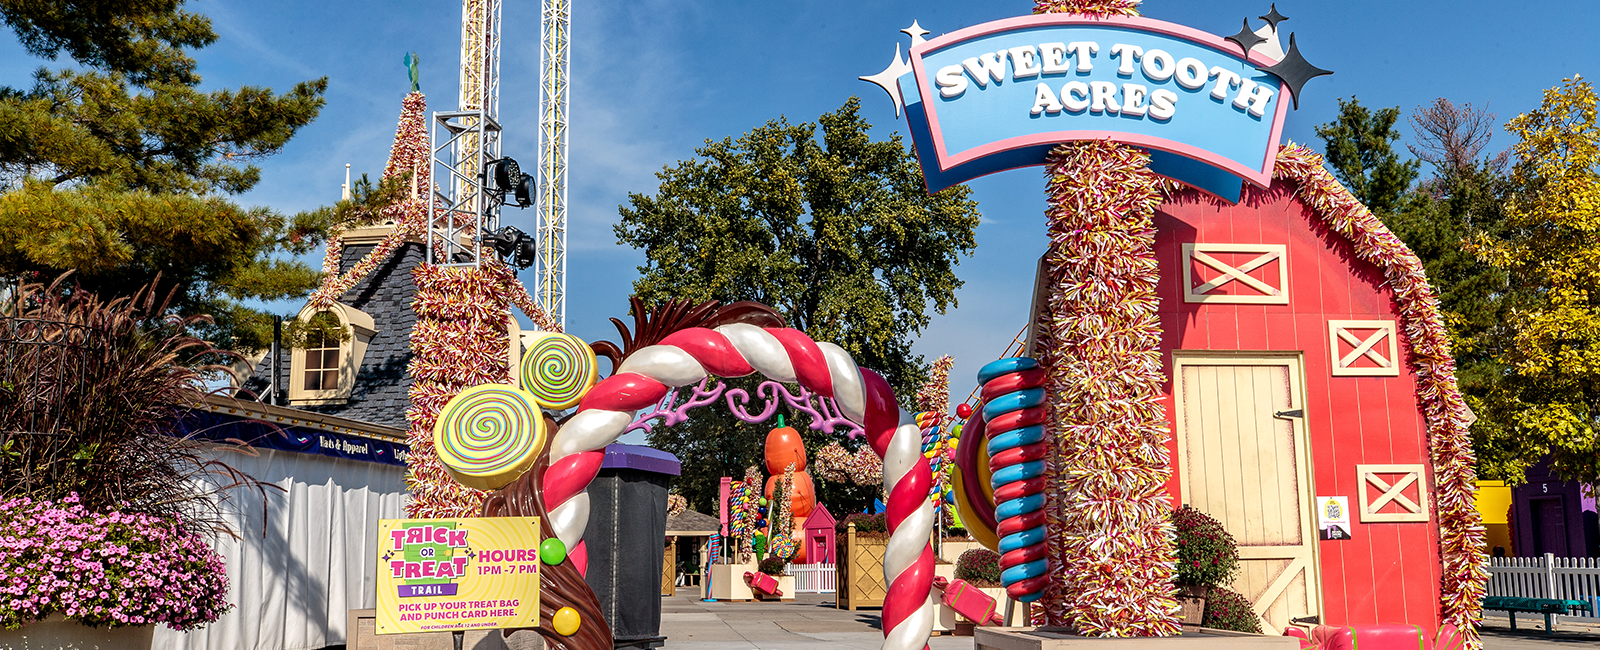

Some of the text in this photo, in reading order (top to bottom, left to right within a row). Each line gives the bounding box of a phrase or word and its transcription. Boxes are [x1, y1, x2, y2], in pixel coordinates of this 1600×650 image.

[935, 41, 1274, 121] SWEET TOOTH
[1030, 80, 1178, 121] ACRES
[335, 439, 341, 450] &
[342, 440, 368, 455] Apparel
[1542, 483, 1548, 493] 5
[391, 525, 468, 550] TRICK
[420, 548, 435, 557] OR
[478, 549, 537, 563] HOURS
[390, 557, 467, 578] TREAT
[478, 566, 501, 575] 1PM
[519, 565, 537, 574] PM
[411, 586, 442, 595] TRAIL
[399, 599, 519, 612] PICK UP YOUR TREAT BAG
[400, 609, 517, 621] AND PUNCH CARD HERE.
